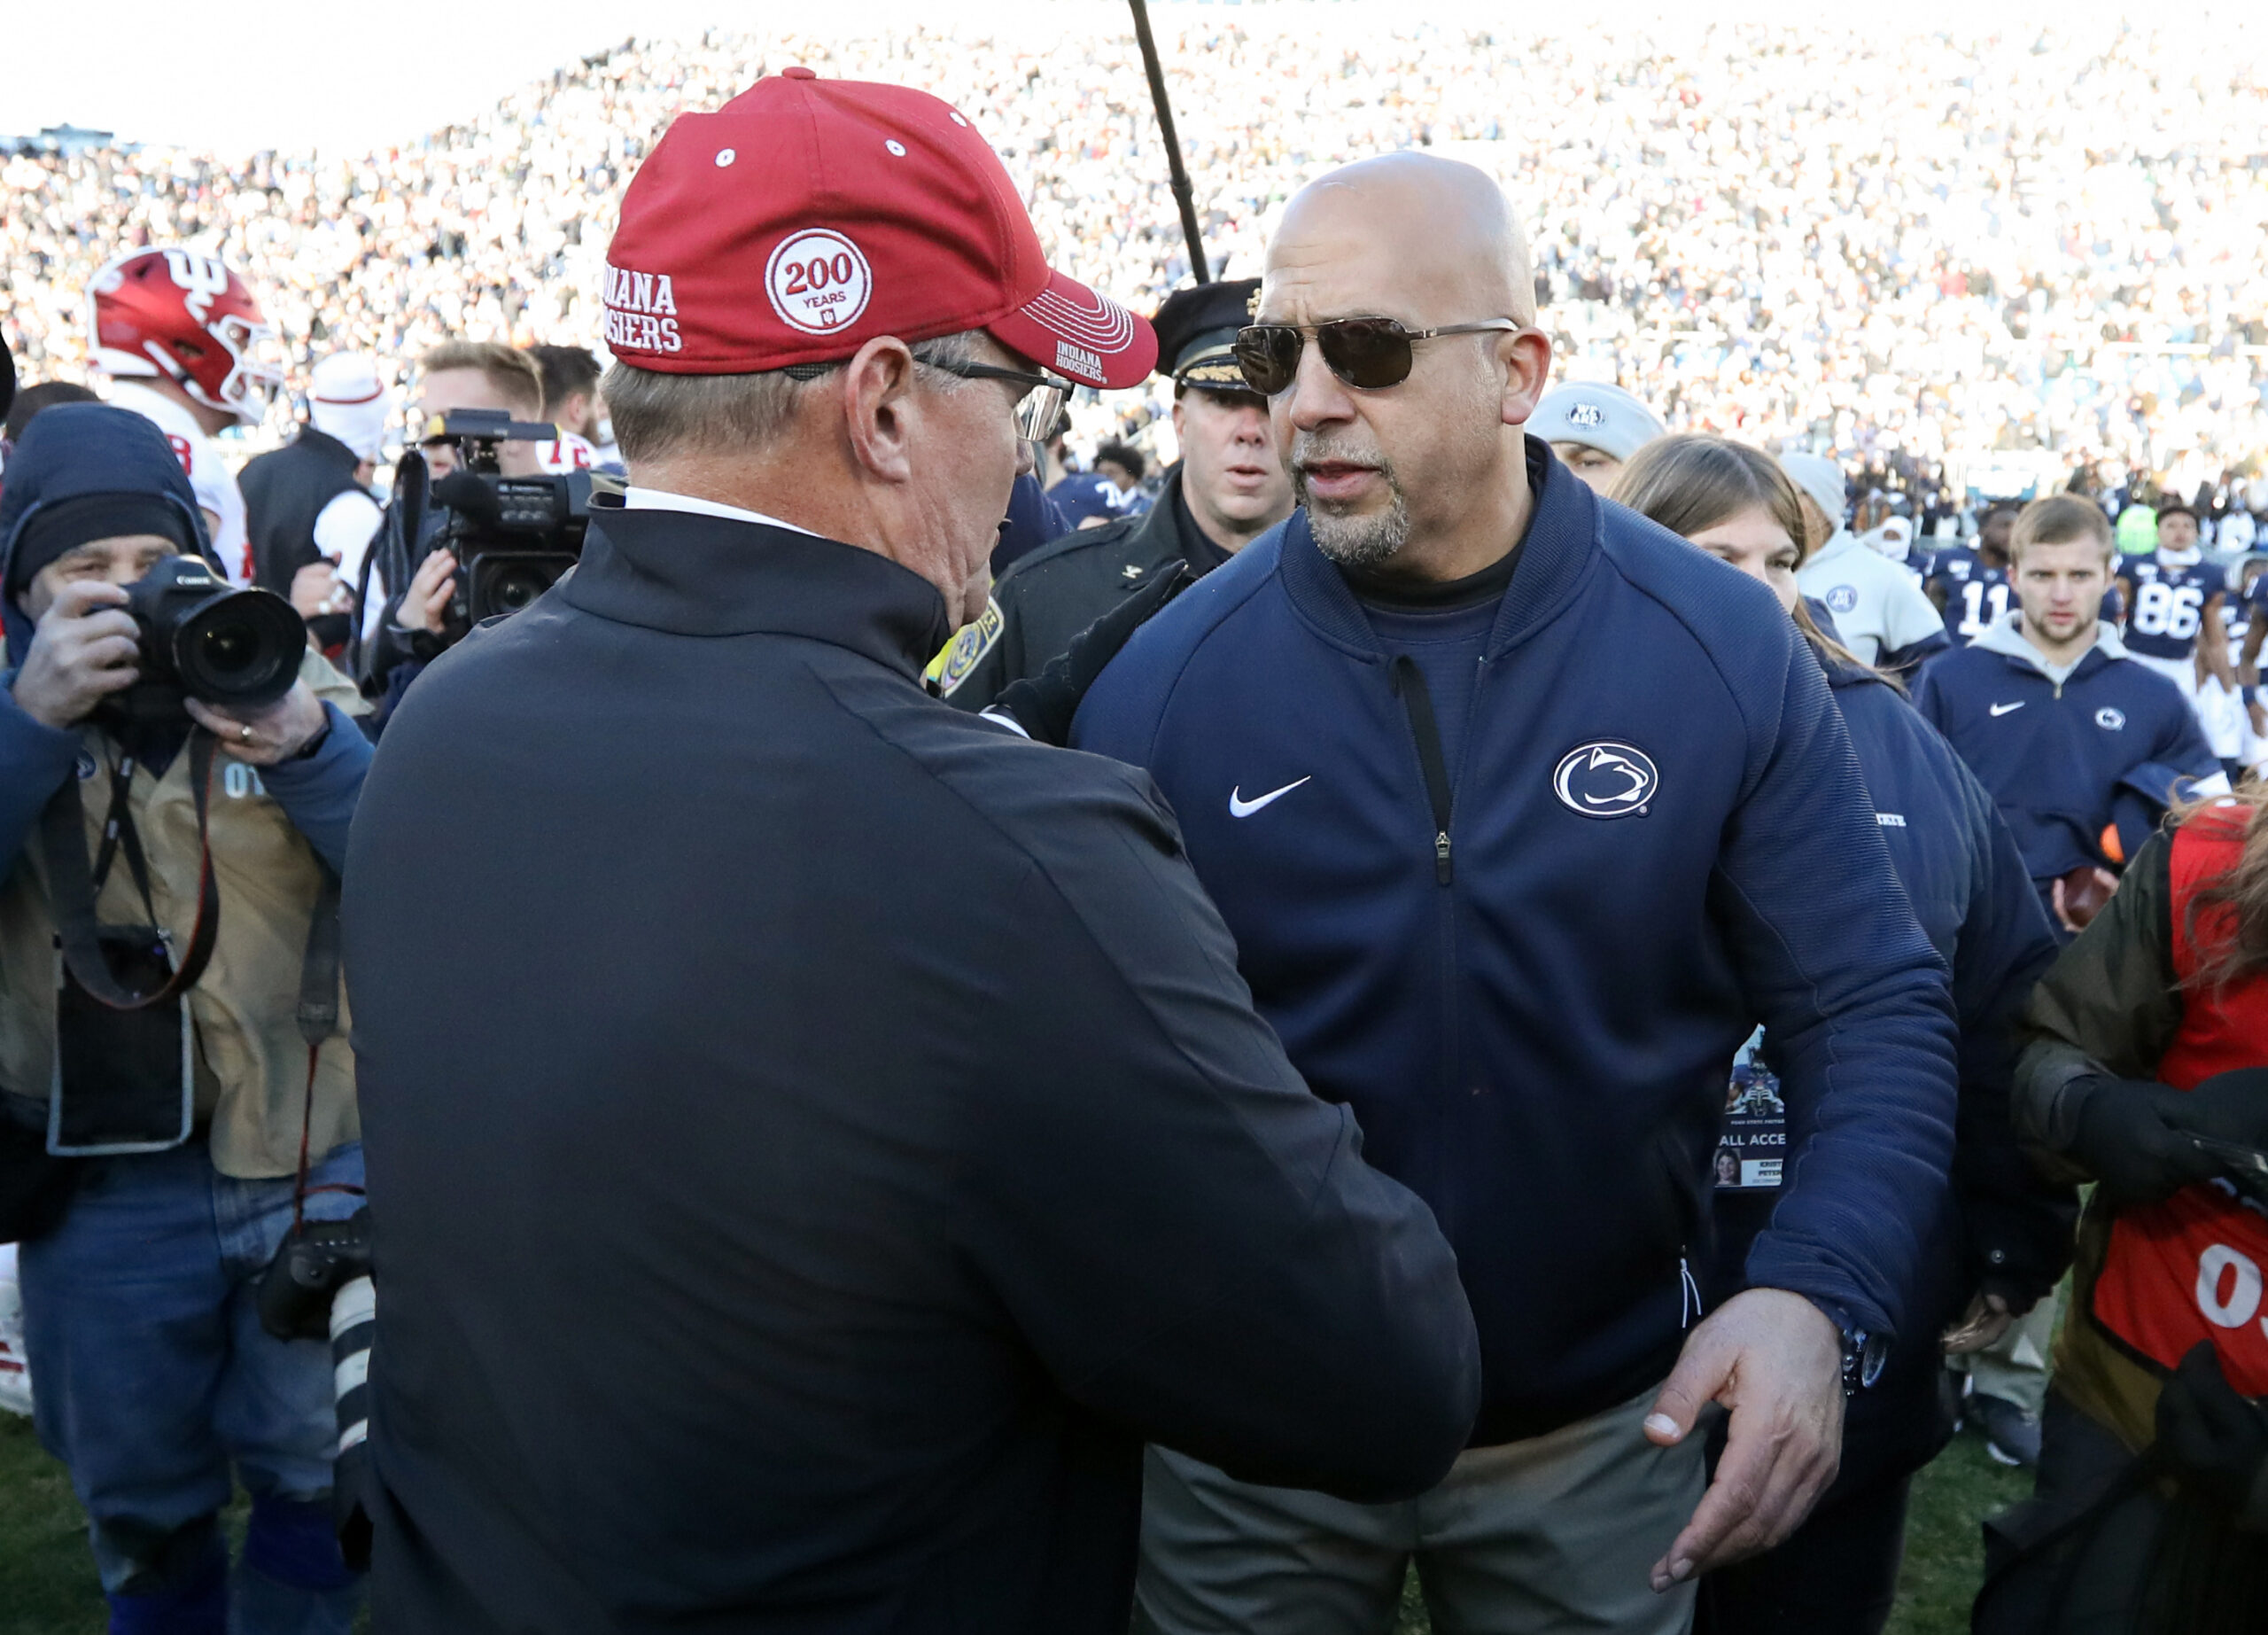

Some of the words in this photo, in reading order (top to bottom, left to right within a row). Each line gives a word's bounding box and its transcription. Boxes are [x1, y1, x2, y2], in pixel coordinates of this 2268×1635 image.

[785, 253, 852, 295] 200
[804, 291, 846, 308] YEARS
[1055, 354, 1103, 382] HOOSIERS
[1056, 339, 1103, 370] INDIANA
[1958, 580, 2009, 636] 11
[2134, 582, 2204, 640] 86
[1719, 1134, 1746, 1147] ALL
[1749, 1133, 1787, 1146] ACCE
